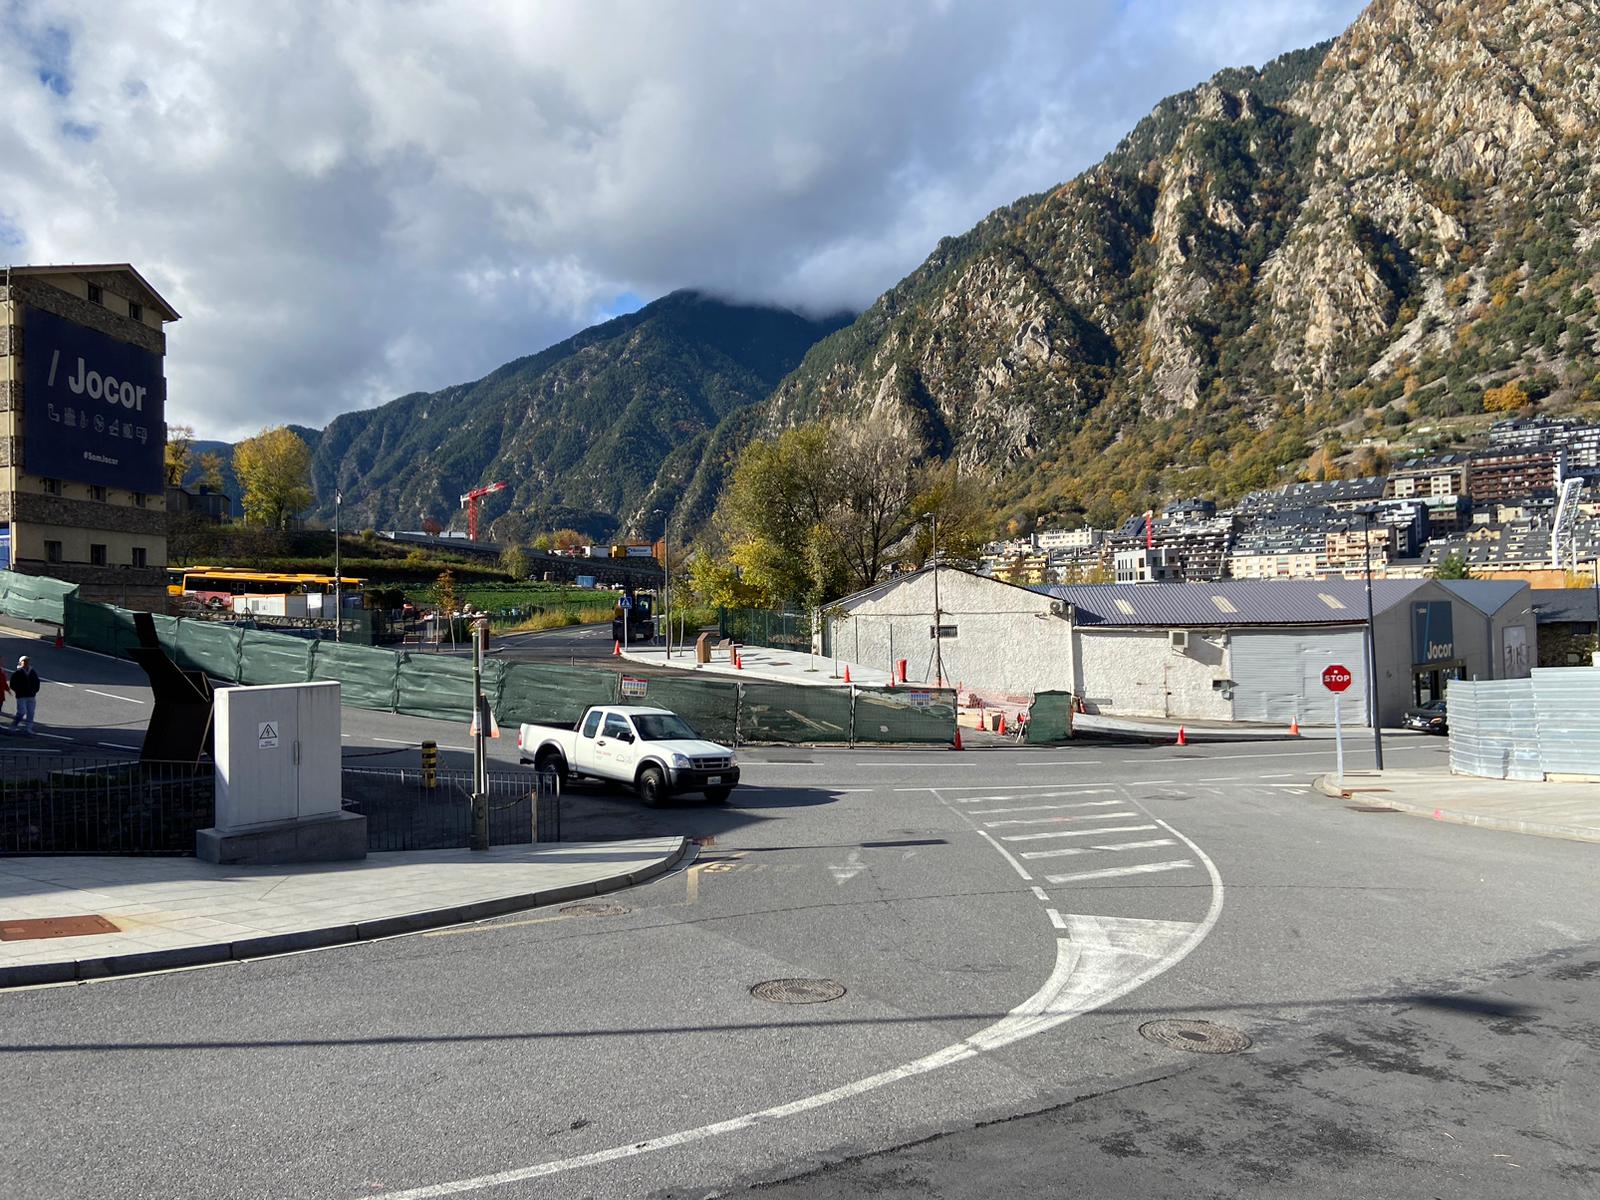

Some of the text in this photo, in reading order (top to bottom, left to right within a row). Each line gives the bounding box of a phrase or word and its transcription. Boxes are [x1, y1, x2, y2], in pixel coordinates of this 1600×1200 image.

[68, 356, 147, 411] Jocor
[1427, 640, 1453, 660] Jocor
[1324, 674, 1350, 682] STOP
